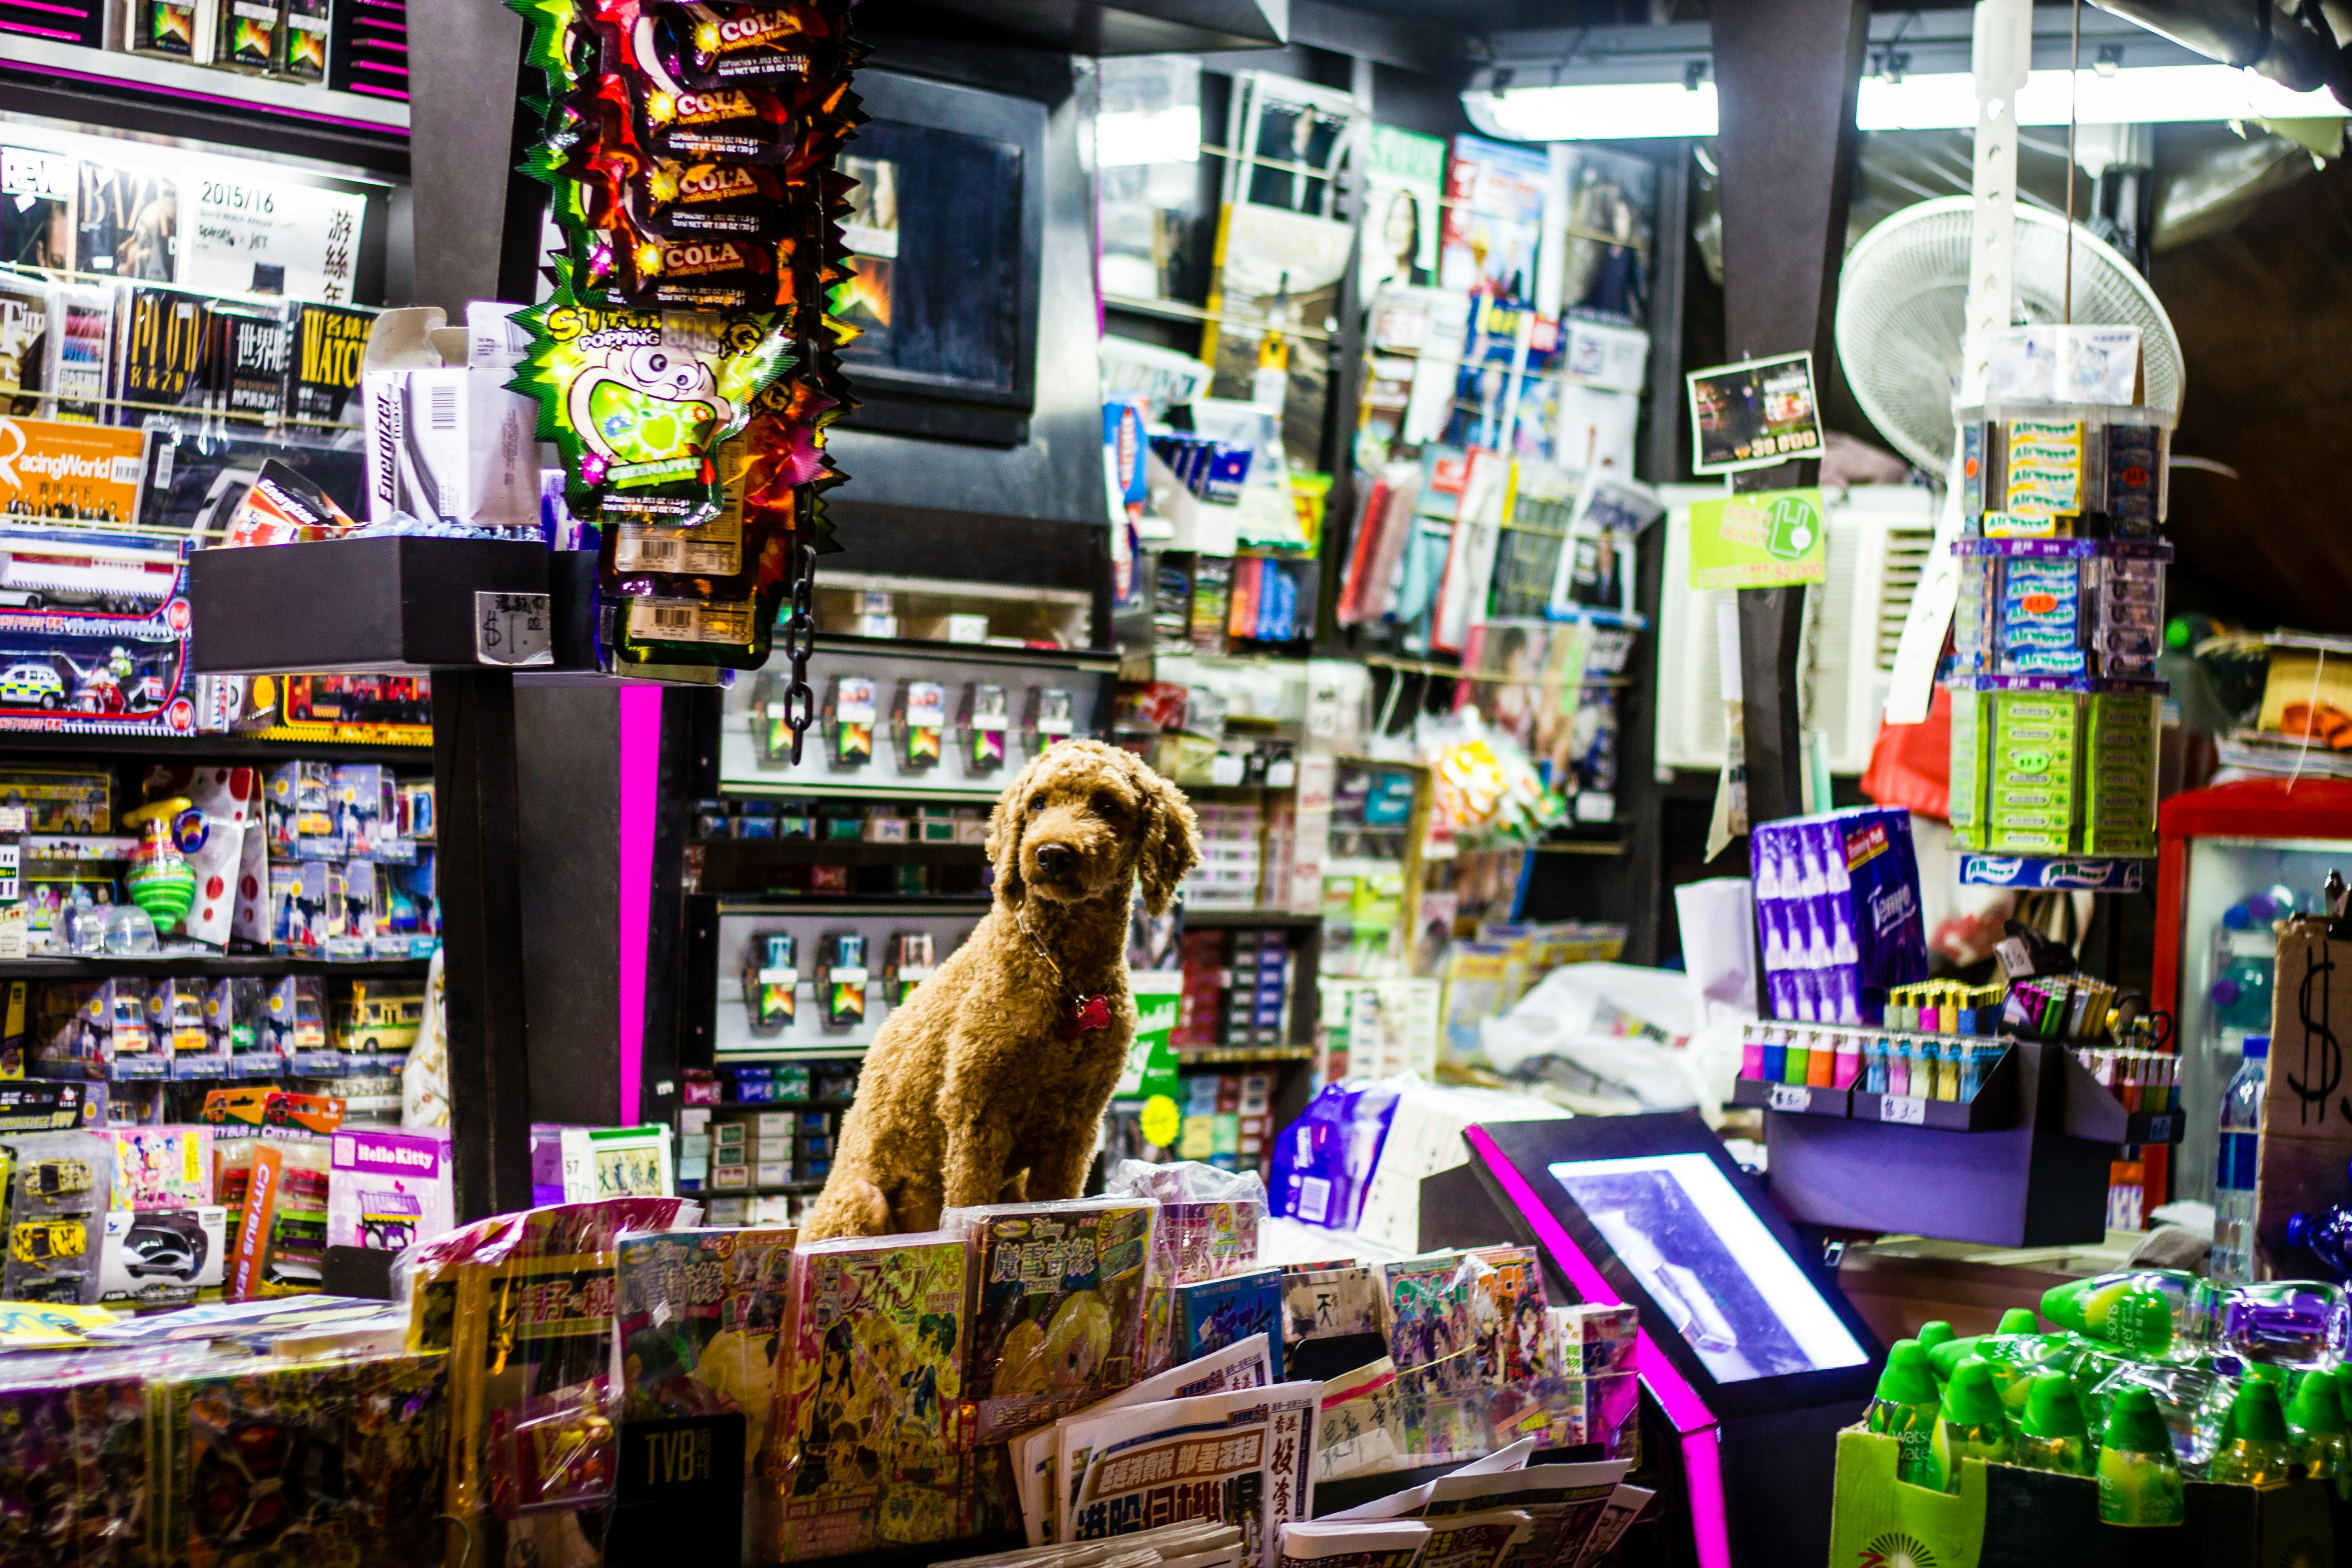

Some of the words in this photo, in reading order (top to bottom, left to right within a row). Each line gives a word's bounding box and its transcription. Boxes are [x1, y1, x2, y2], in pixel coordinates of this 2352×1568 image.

[720, 9, 791, 42] COLA
[677, 90, 752, 115] COLA
[681, 167, 754, 193] COLA
[202, 181, 273, 213] 2015/16
[666, 242, 740, 268] COLA
[579, 329, 660, 351] POPPING
[2014, 422, 2076, 436] Airwaves
[375, 392, 395, 507] Energizer
[2014, 446, 2076, 460] Airwaves
[2013, 470, 2075, 484] Airwaves
[258, 479, 318, 525] Energizer
[1988, 515, 2050, 528] Airwaves
[358, 1144, 394, 1164] Hello
[394, 1147, 434, 1169] Kitty
[244, 1163, 271, 1256] CITYBUS
[1274, 1414, 1298, 1434] 香港
[644, 1429, 694, 1486] TVB
